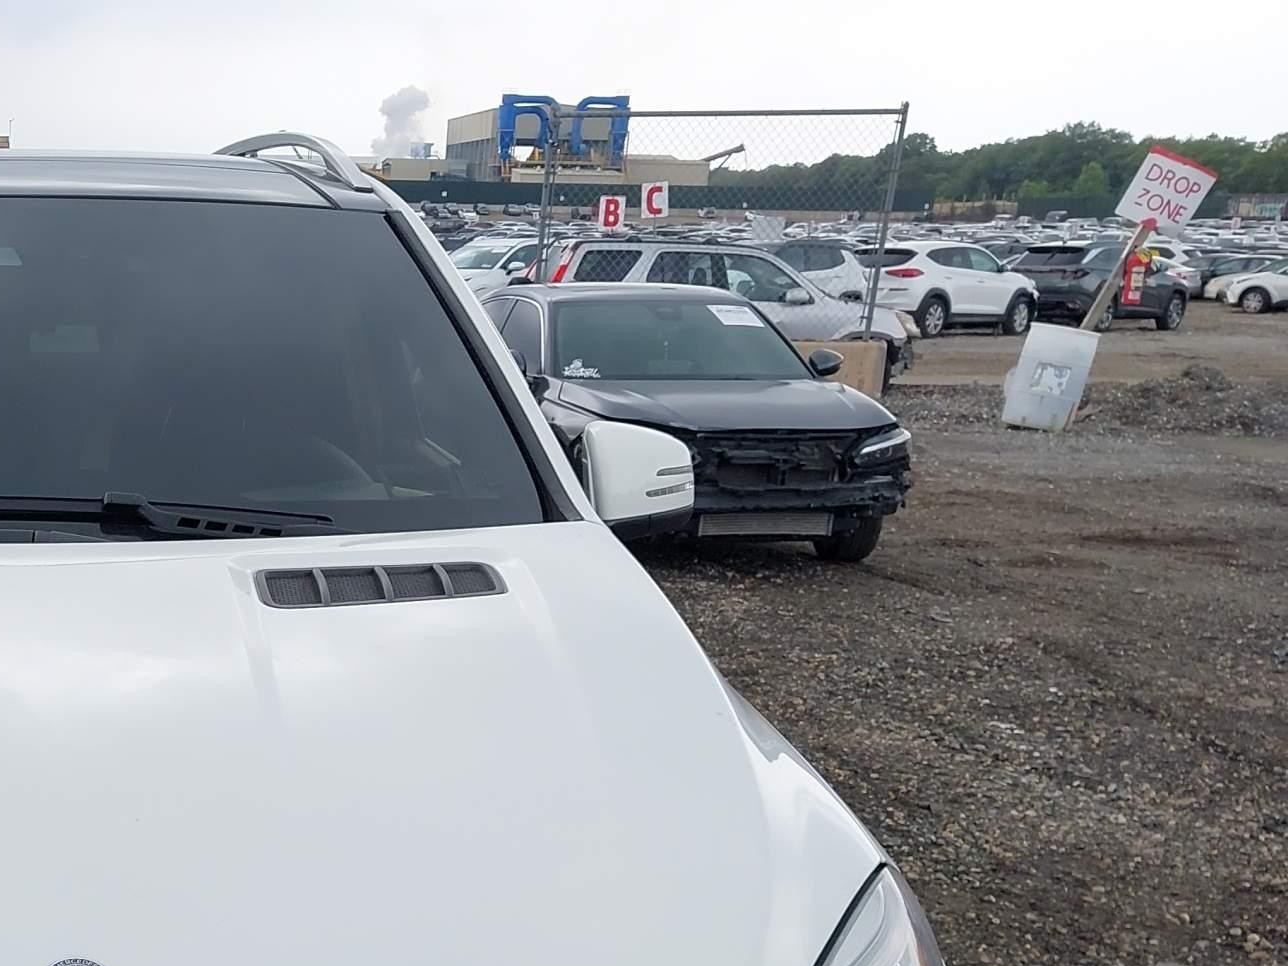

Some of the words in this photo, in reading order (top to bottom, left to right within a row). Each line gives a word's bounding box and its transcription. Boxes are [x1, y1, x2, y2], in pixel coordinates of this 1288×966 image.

[1145, 163, 1201, 198] DROP
[603, 198, 620, 228] B
[646, 185, 663, 215] C
[1134, 188, 1187, 224] ZONE
